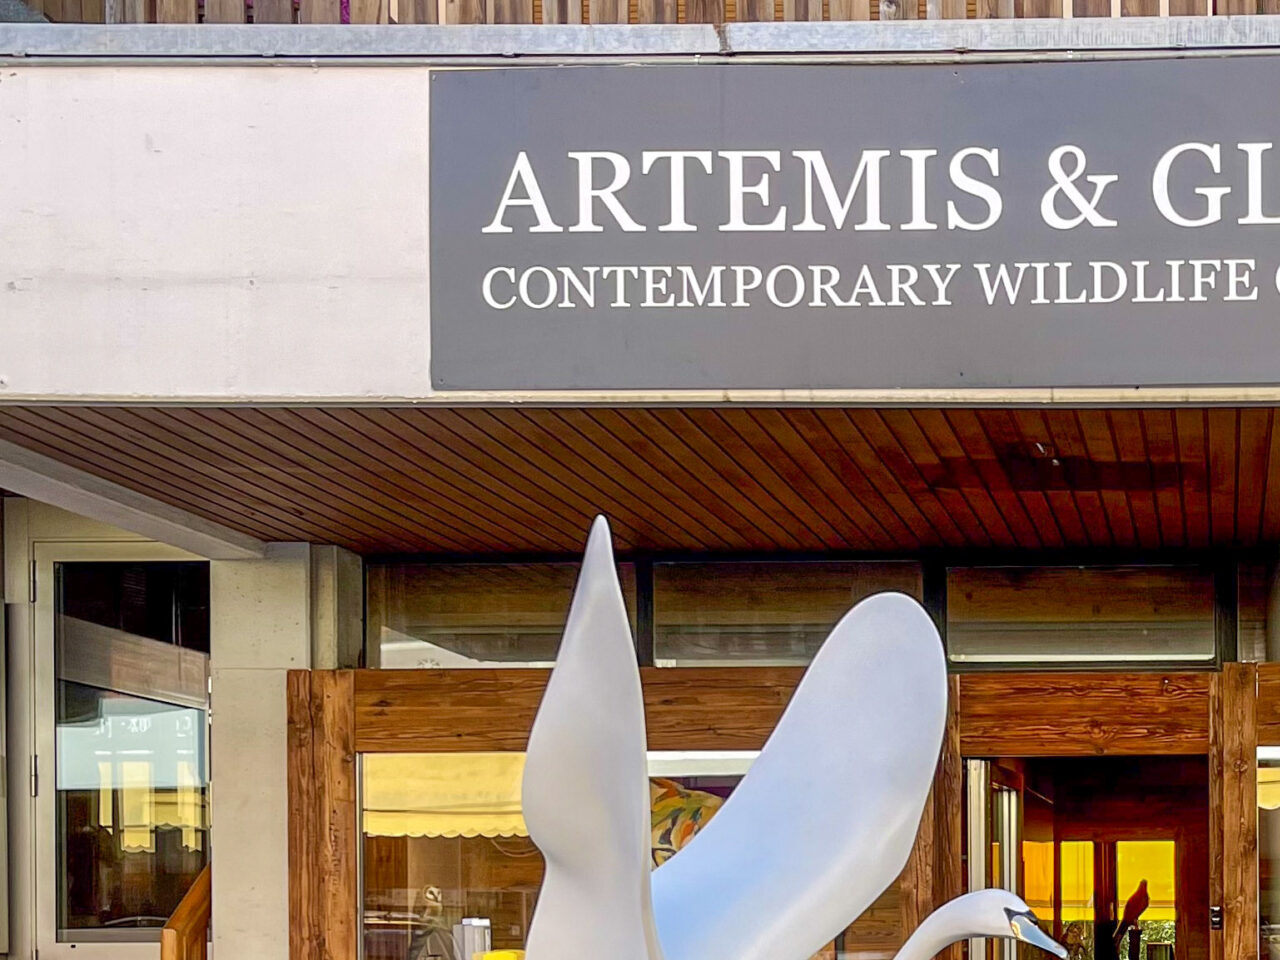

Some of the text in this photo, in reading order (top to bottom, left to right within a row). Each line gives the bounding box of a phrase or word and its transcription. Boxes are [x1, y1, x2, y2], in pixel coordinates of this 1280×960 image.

[481, 147, 1003, 233] ARTEMIS
[1040, 144, 1119, 230] &
[482, 263, 962, 309] CONTEMPORARY
[973, 258, 1259, 305] WILDLIFE
